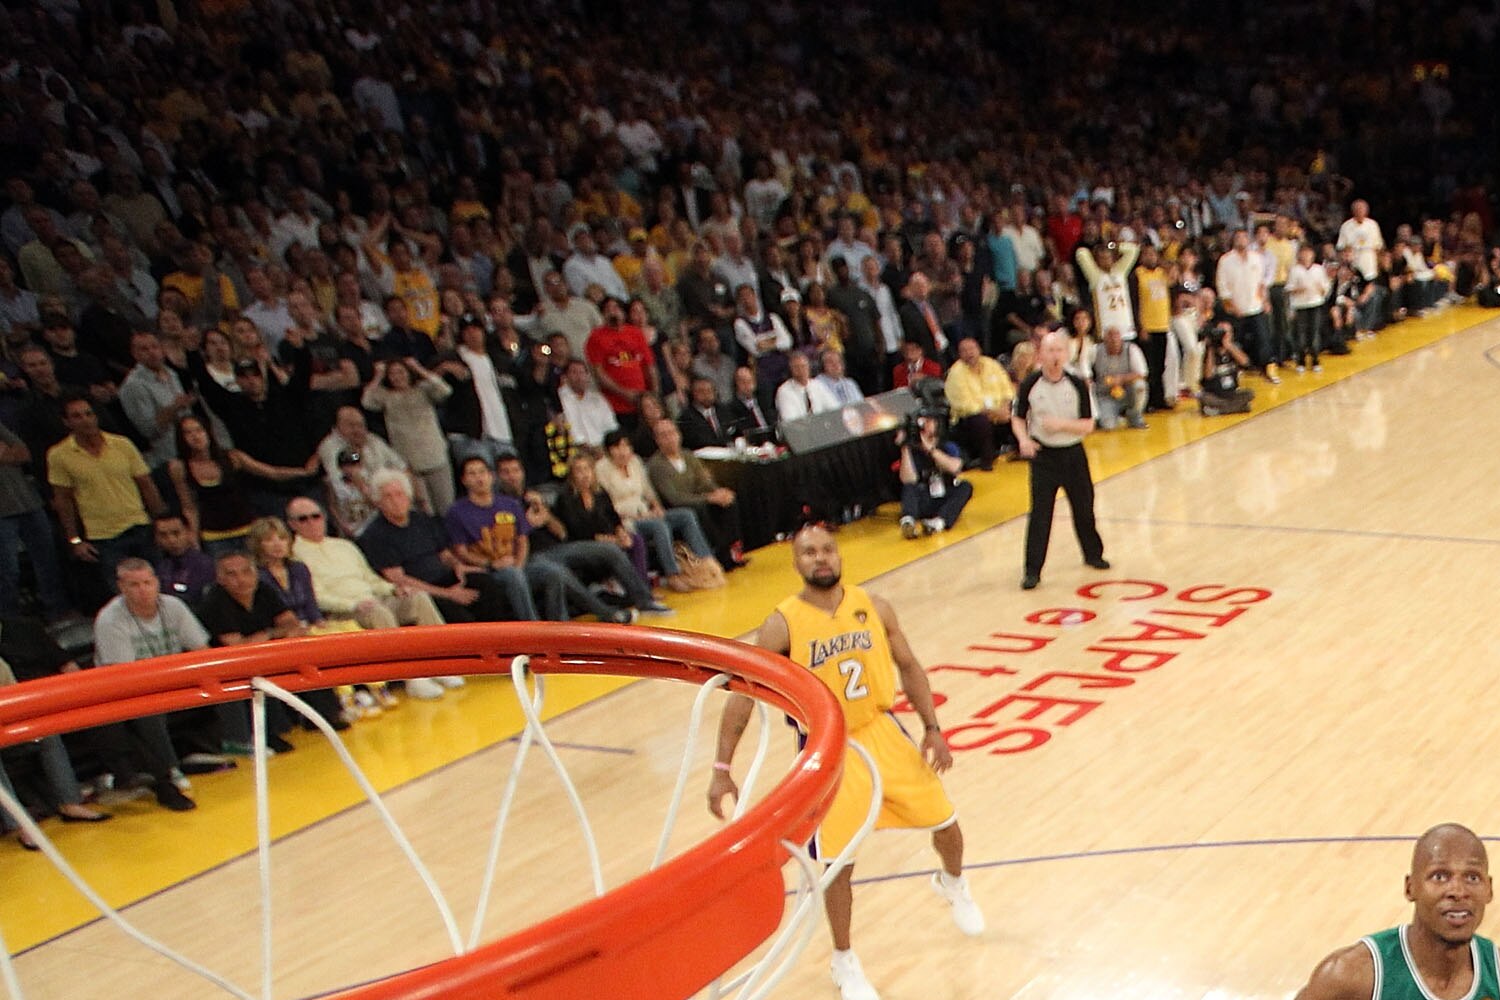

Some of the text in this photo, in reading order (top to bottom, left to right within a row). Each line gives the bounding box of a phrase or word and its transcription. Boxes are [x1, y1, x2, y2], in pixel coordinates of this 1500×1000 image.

[808, 630, 872, 669] LAKERS
[942, 583, 1273, 755] STAPLES
[838, 657, 869, 701] 2
